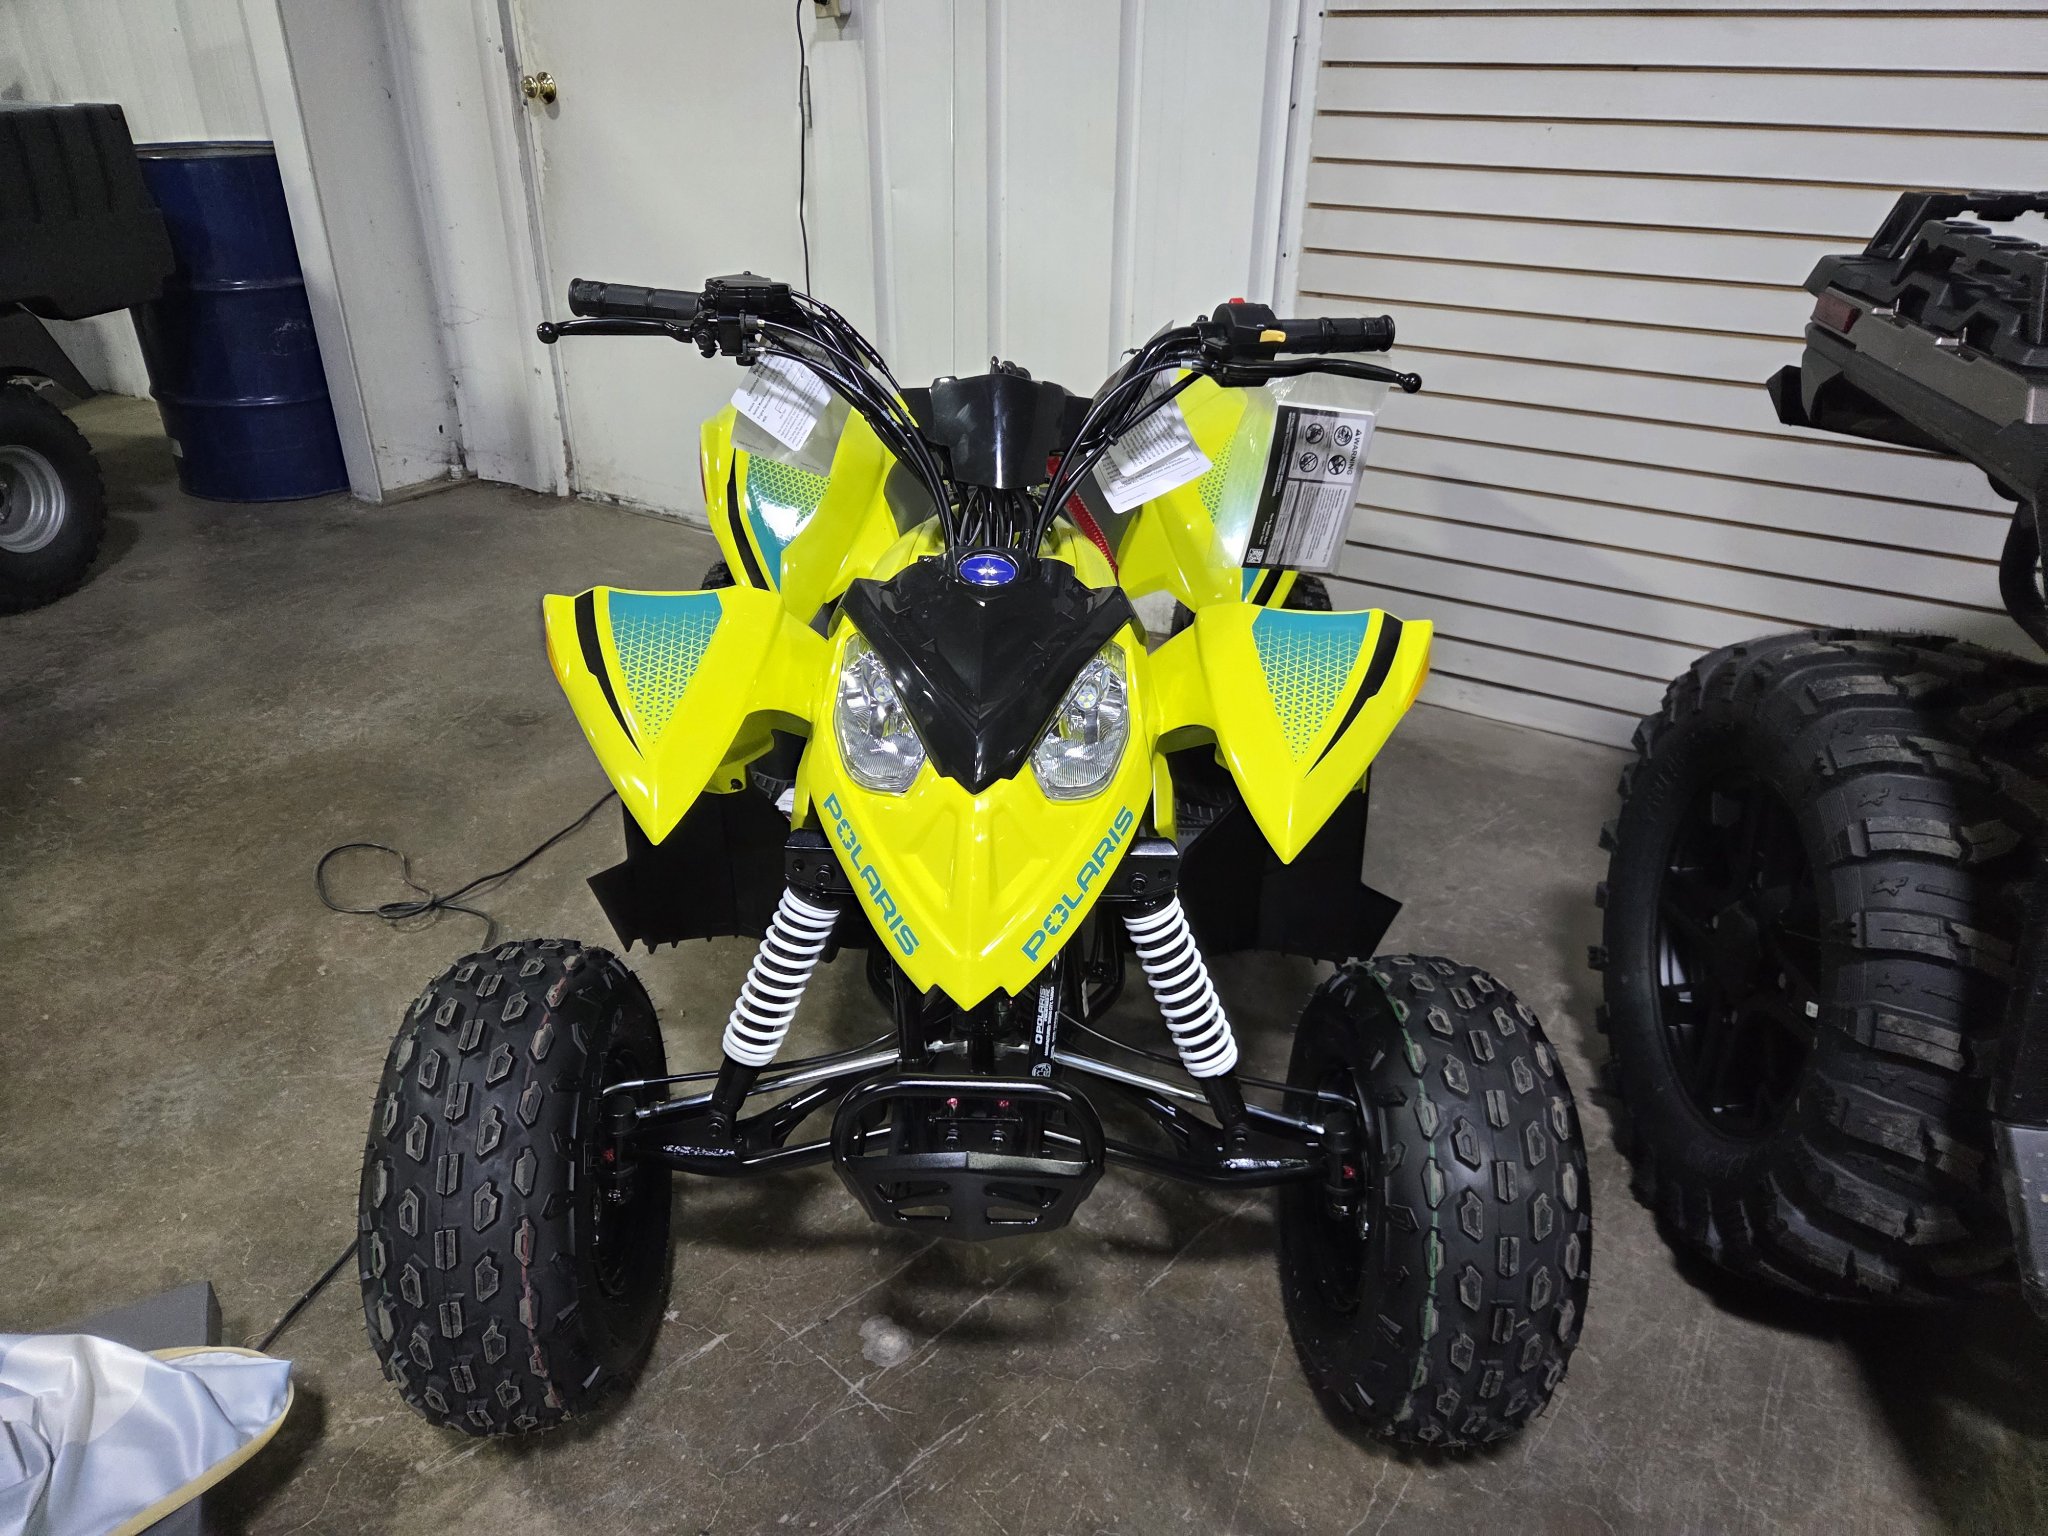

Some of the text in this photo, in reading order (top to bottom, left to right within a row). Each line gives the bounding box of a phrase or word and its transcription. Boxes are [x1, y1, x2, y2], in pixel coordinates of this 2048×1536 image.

[1347, 436, 1361, 475] WARNING
[823, 792, 920, 957] POLARIS
[1021, 805, 1135, 962] POLARIS
[1036, 988, 1046, 1033] POLARIS
